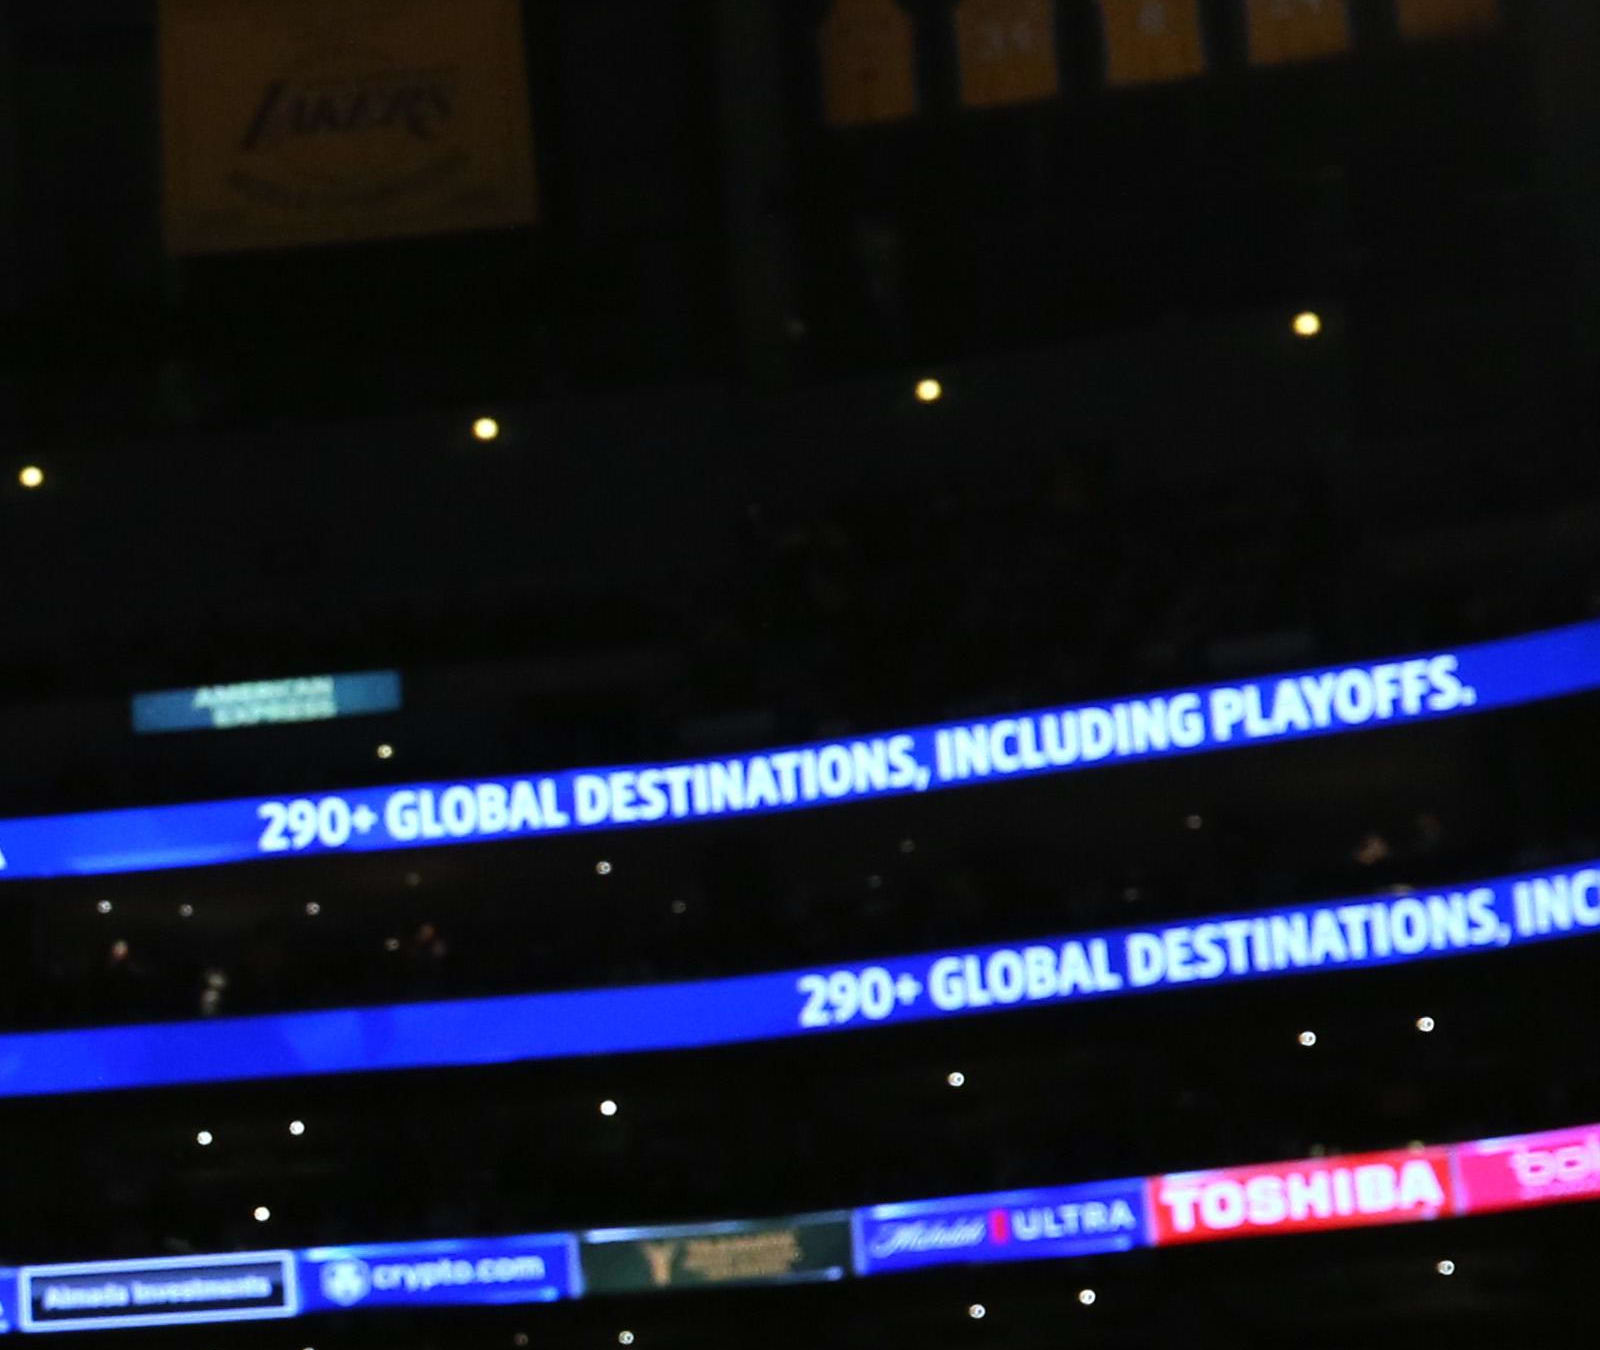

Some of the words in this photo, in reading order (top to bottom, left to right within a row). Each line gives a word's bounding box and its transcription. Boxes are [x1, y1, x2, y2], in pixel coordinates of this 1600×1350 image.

[258, 796, 377, 851] 290+
[385, 778, 567, 841] GLOBAL
[574, 734, 931, 826] DESTINATIONS,
[936, 692, 1205, 782] INCLUDING
[1209, 654, 1476, 742] PLAYOFFS.
[800, 967, 922, 1029] 290+
[930, 937, 1123, 1012] GLOBAL
[1126, 886, 1512, 989] DESTINATIONS,
[1010, 1199, 1137, 1242] ULTRA
[1160, 1158, 1445, 1234] TOSHIBA
[371, 1255, 546, 1293] crypto.com
